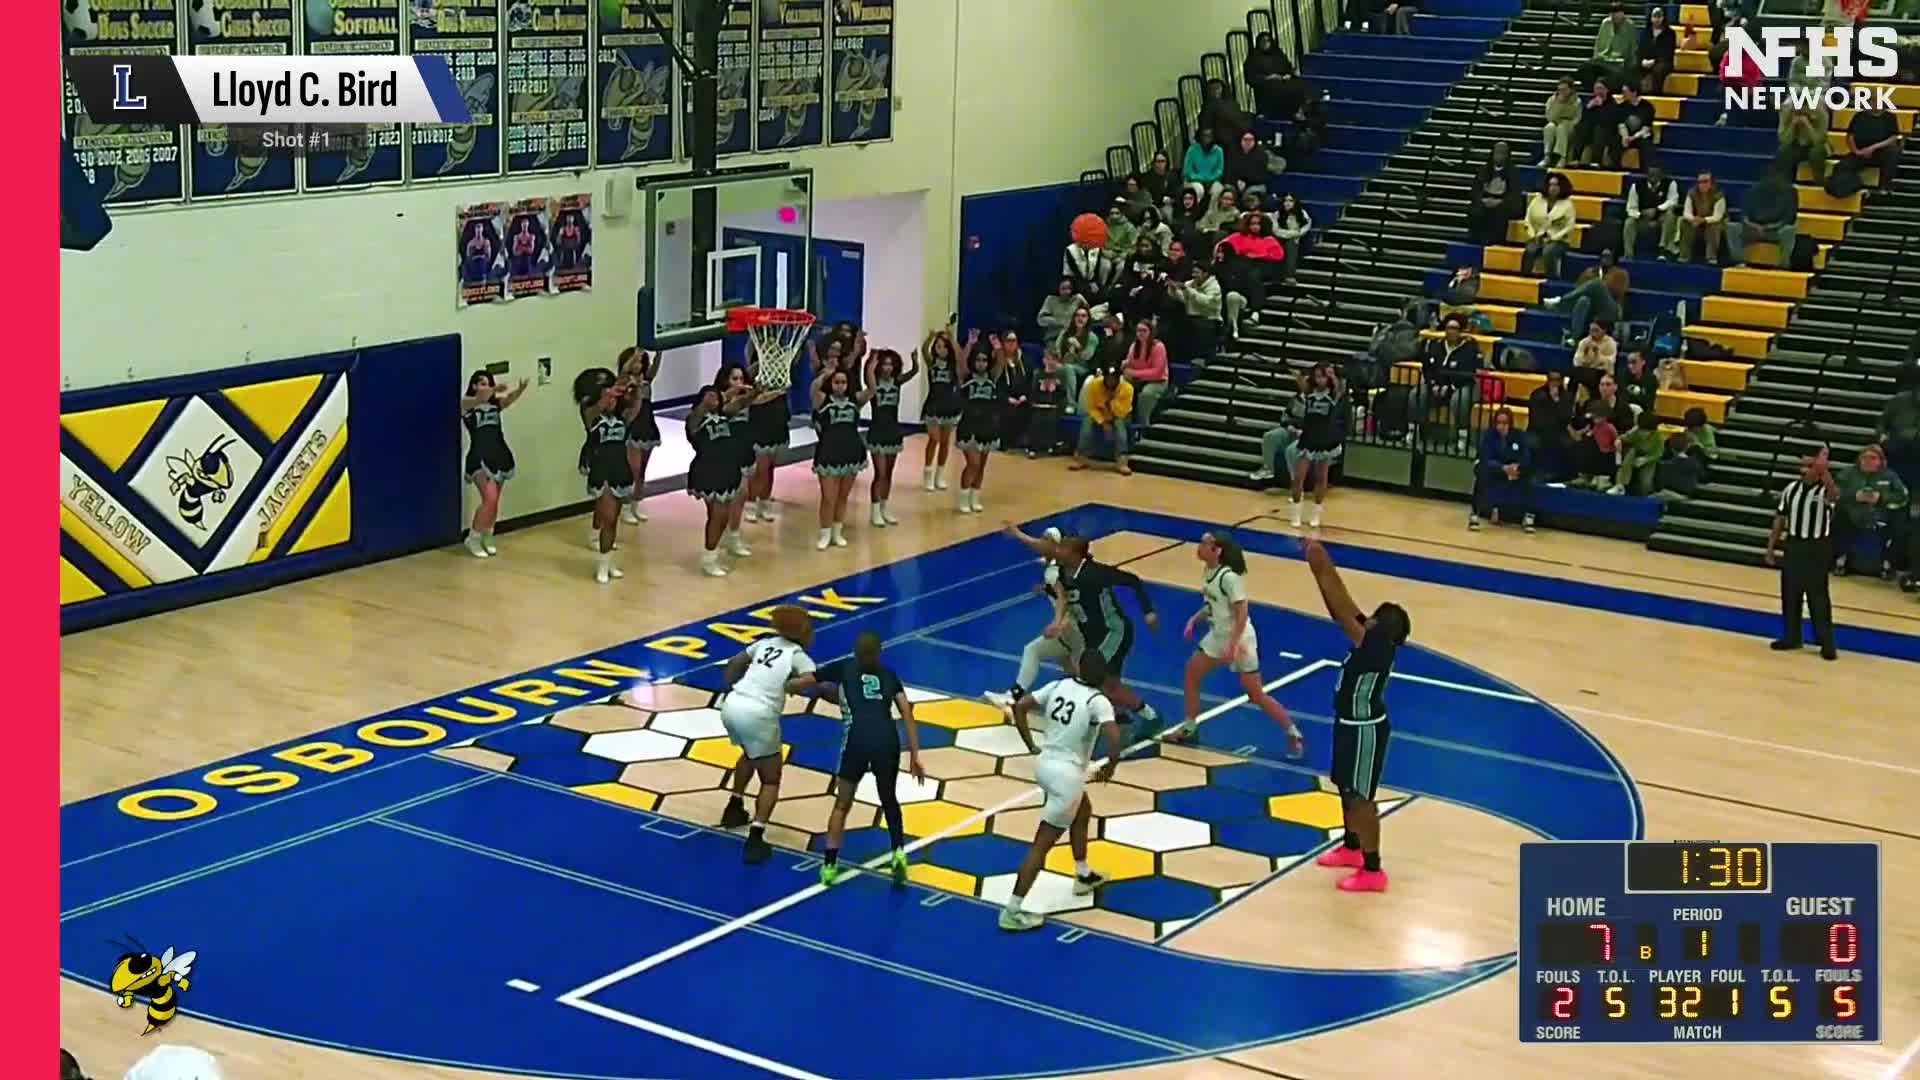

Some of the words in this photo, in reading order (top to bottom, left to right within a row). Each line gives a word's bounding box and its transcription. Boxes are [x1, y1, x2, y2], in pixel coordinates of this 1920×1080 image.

[334, 9, 398, 35] SOFTBALL
[152, 146, 178, 162] 2007
[257, 429, 327, 530] JACKETS
[69, 474, 151, 556] YELLOW
[757, 646, 783, 668] 32
[861, 674, 883, 699] 2
[1051, 696, 1075, 725] 23
[117, 658, 650, 821] OSBOURN
